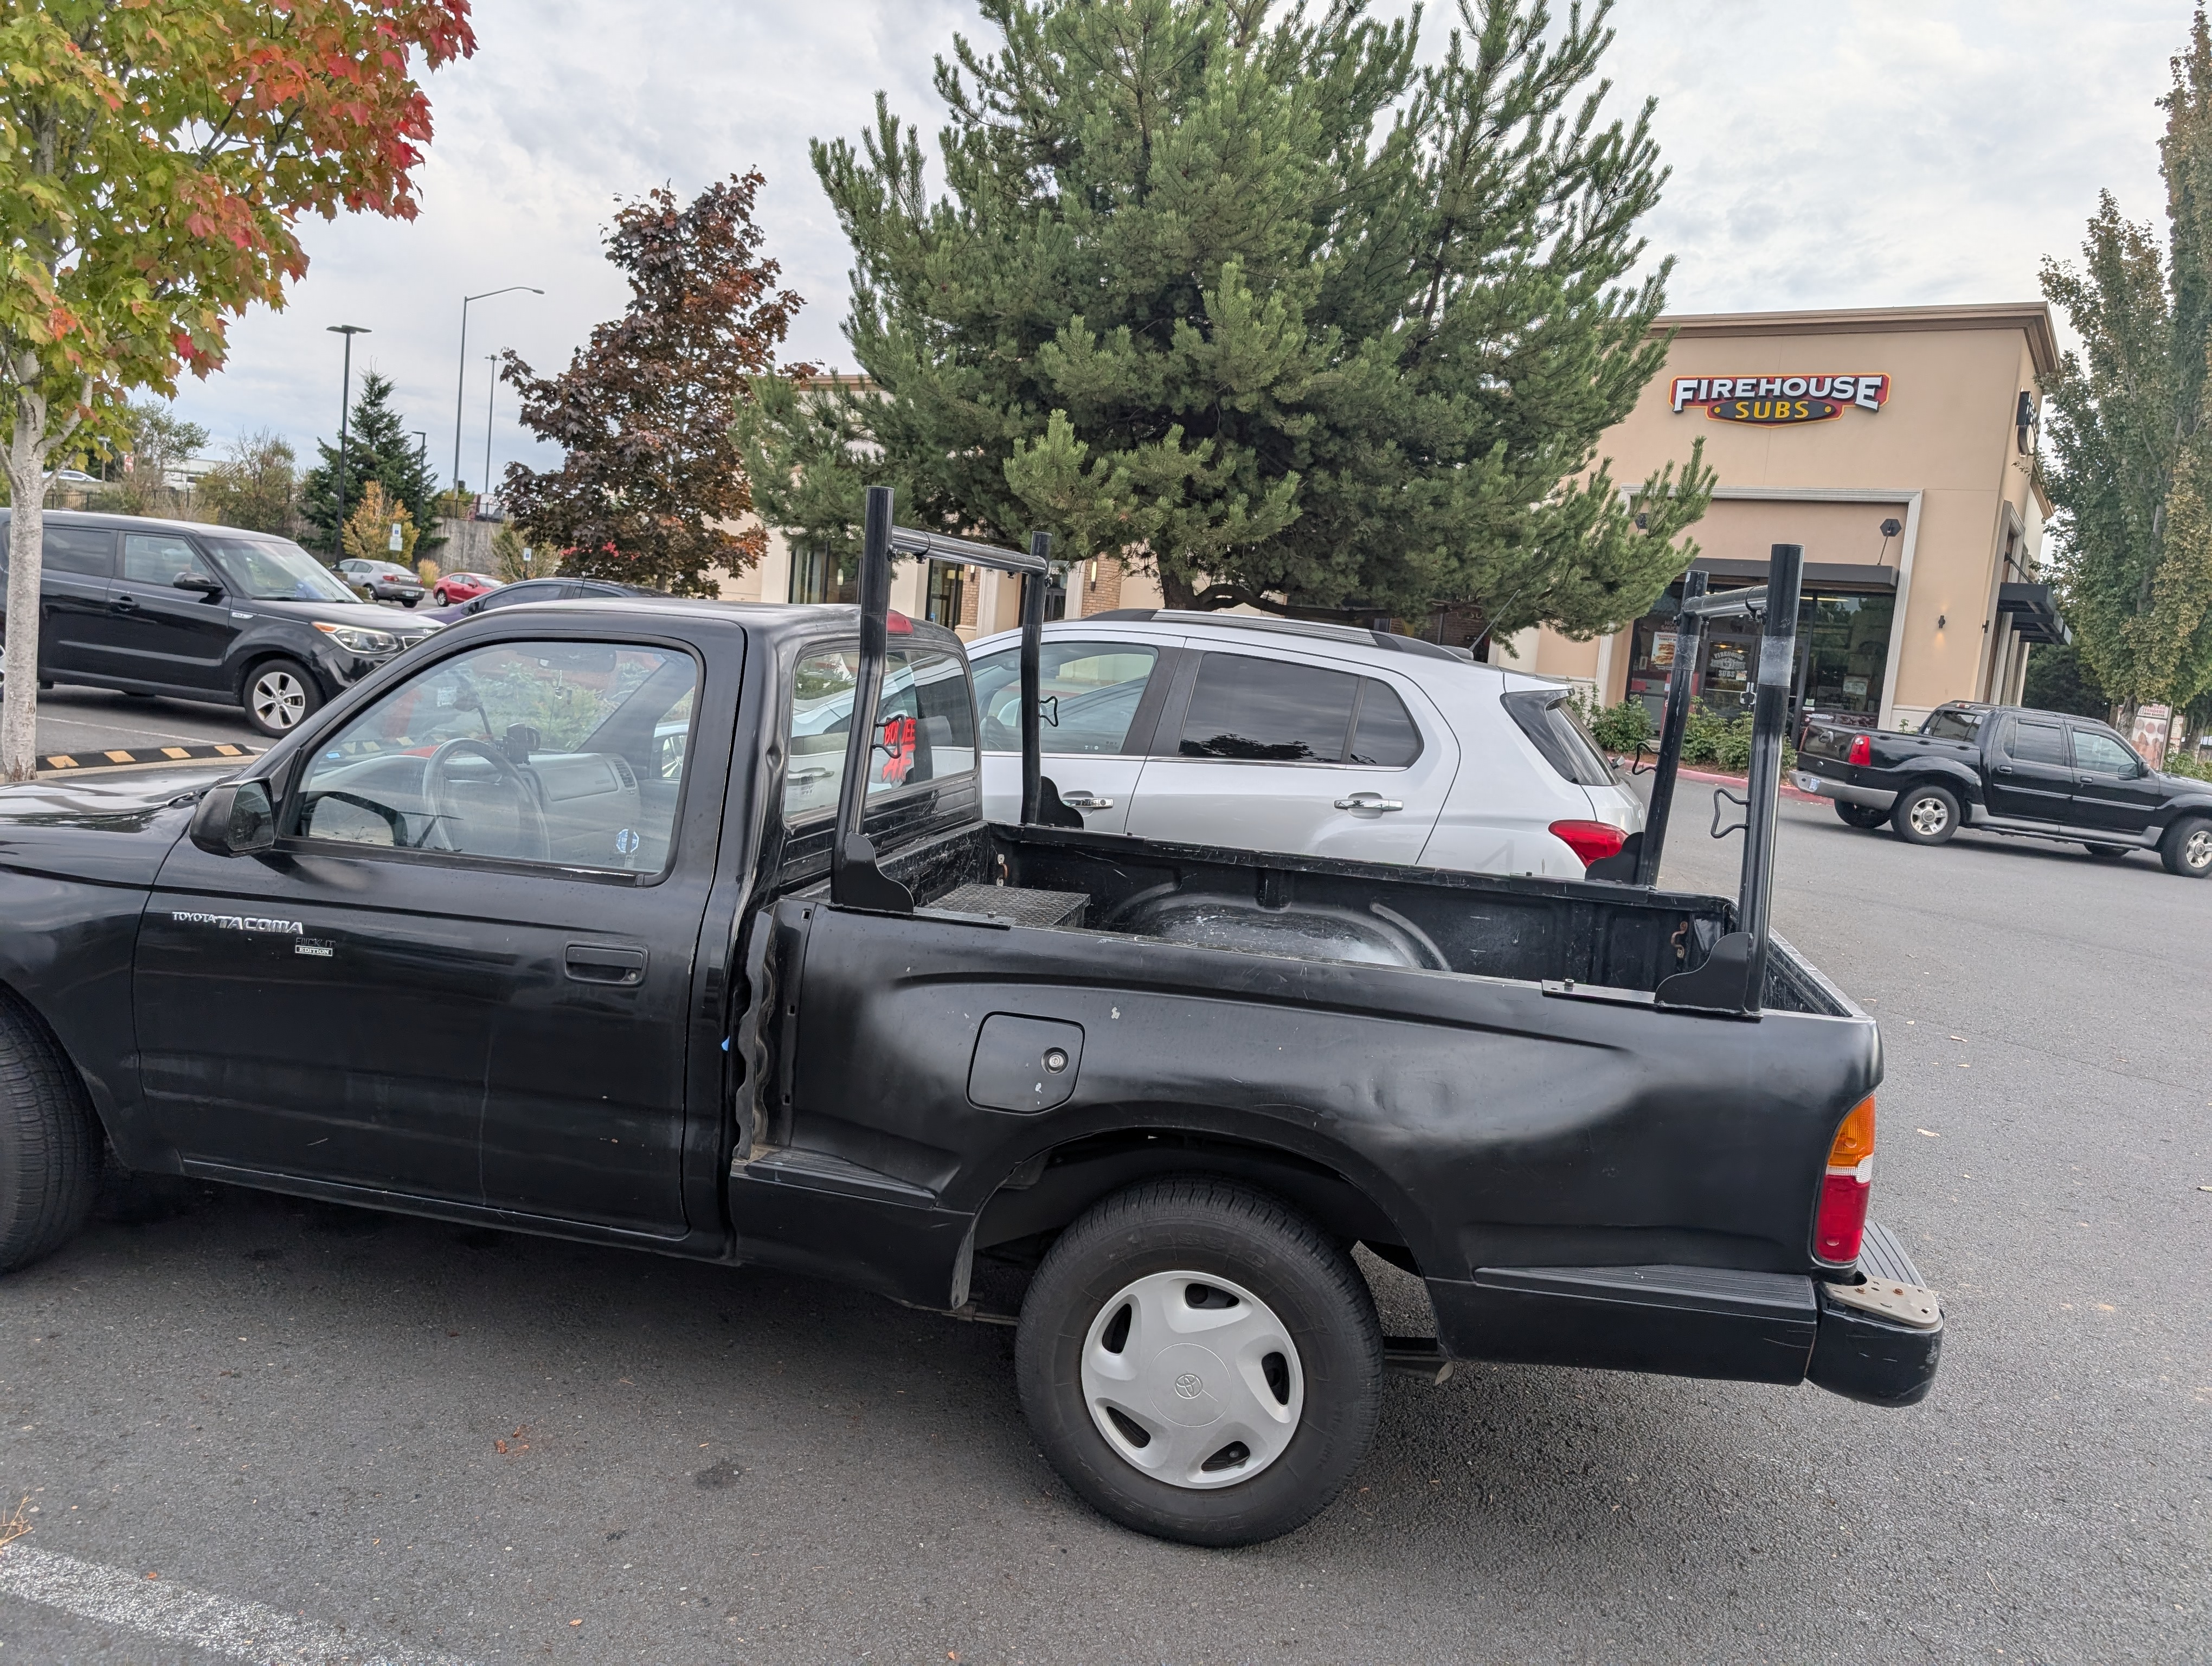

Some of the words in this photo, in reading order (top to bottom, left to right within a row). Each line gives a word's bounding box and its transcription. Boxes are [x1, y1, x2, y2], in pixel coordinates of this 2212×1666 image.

[1672, 375, 1882, 412] FIREHOUSE
[1735, 401, 1809, 419] SUBS
[1713, 651, 1745, 661] FIREHOUSE
[882, 744, 916, 783] AF
[172, 912, 216, 924] TOYOTA
[216, 915, 304, 934] TACOMA
[295, 937, 323, 946] FUCK
